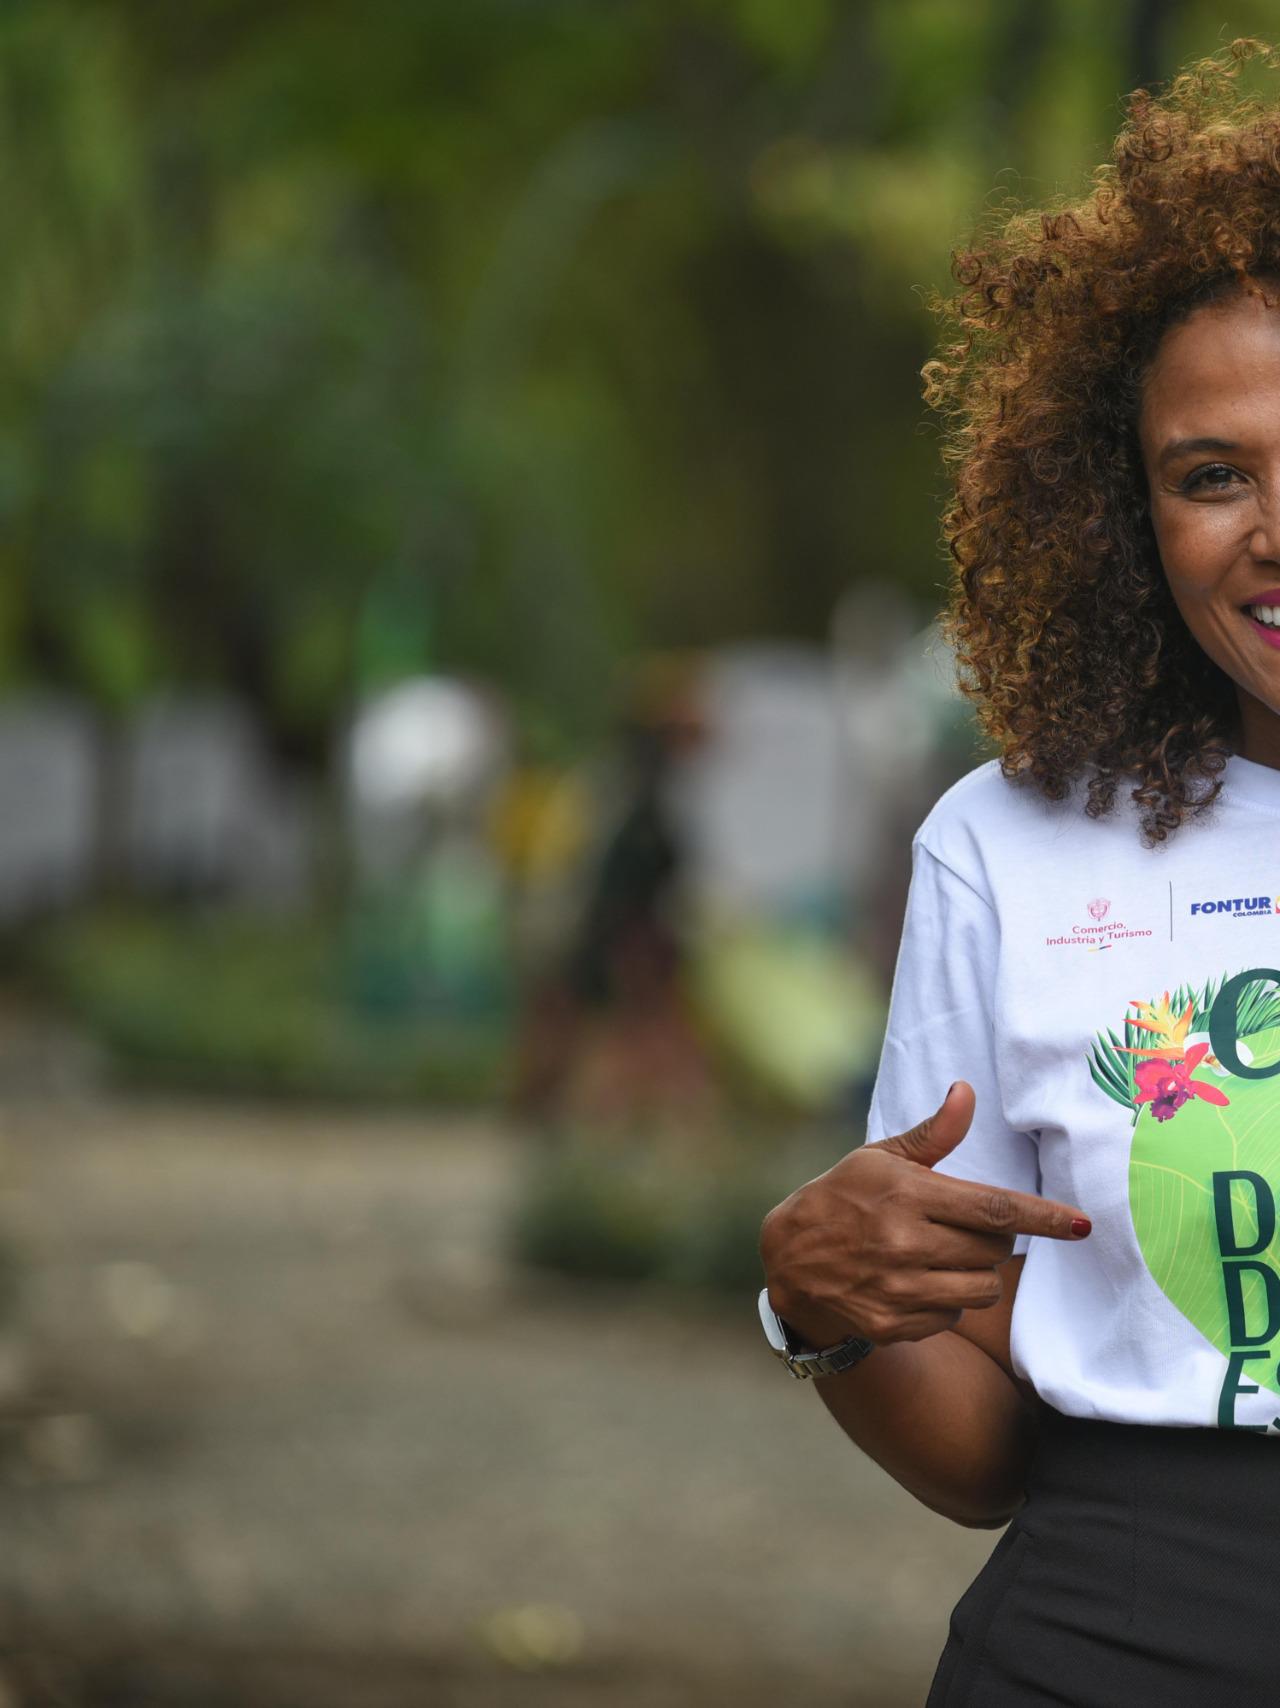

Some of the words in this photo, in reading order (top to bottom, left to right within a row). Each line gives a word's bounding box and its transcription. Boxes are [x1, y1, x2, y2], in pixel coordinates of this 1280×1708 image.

[1191, 897, 1271, 915] FONTUR
[1232, 909, 1272, 918] COLOMBIA
[1072, 922, 1126, 934] Comercio,
[1046, 935, 1096, 946] Industria
[1098, 936, 1105, 944] y
[1107, 929, 1153, 940] Turismo
